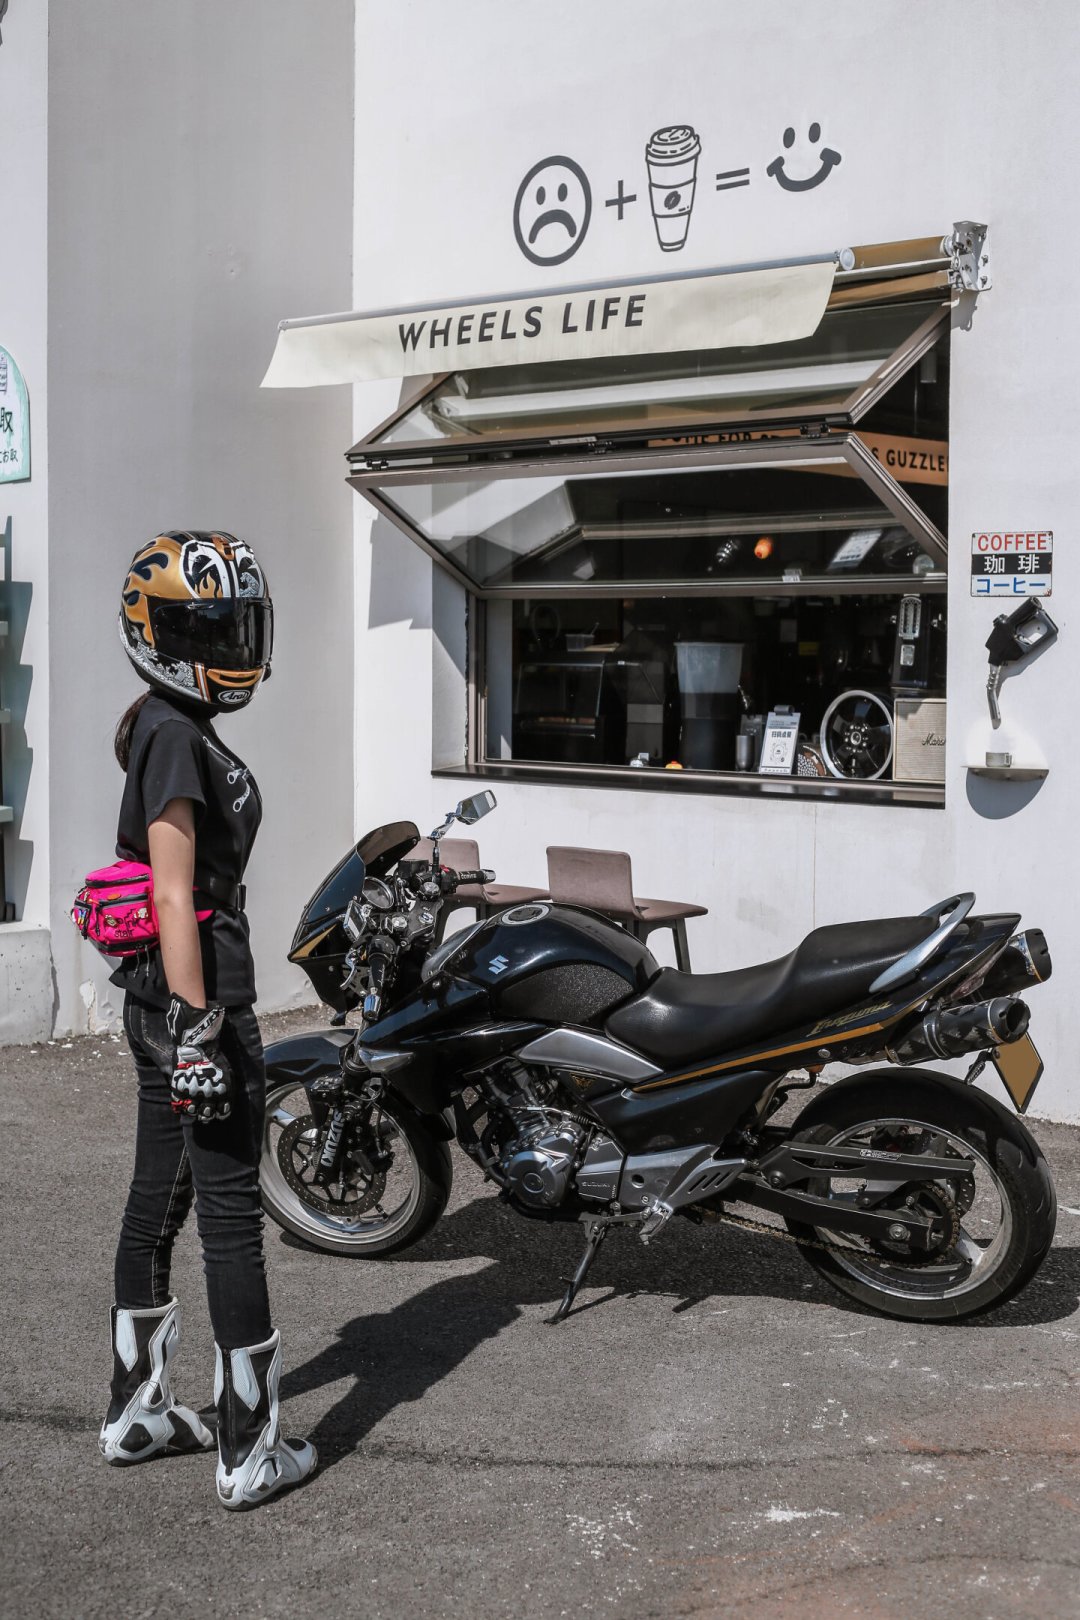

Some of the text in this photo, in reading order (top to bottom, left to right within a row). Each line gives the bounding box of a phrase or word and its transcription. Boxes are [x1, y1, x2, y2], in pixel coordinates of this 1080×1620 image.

[398, 294, 647, 352] WHEELS LIFE
[886, 449, 949, 472] GUZZLE
[978, 533, 1047, 551] COFFEE
[984, 554, 1040, 574] 珈琲
[976, 577, 1046, 594] コーヒー
[220, 690, 249, 701] Arai
[320, 1108, 345, 1168] SUZUKI
